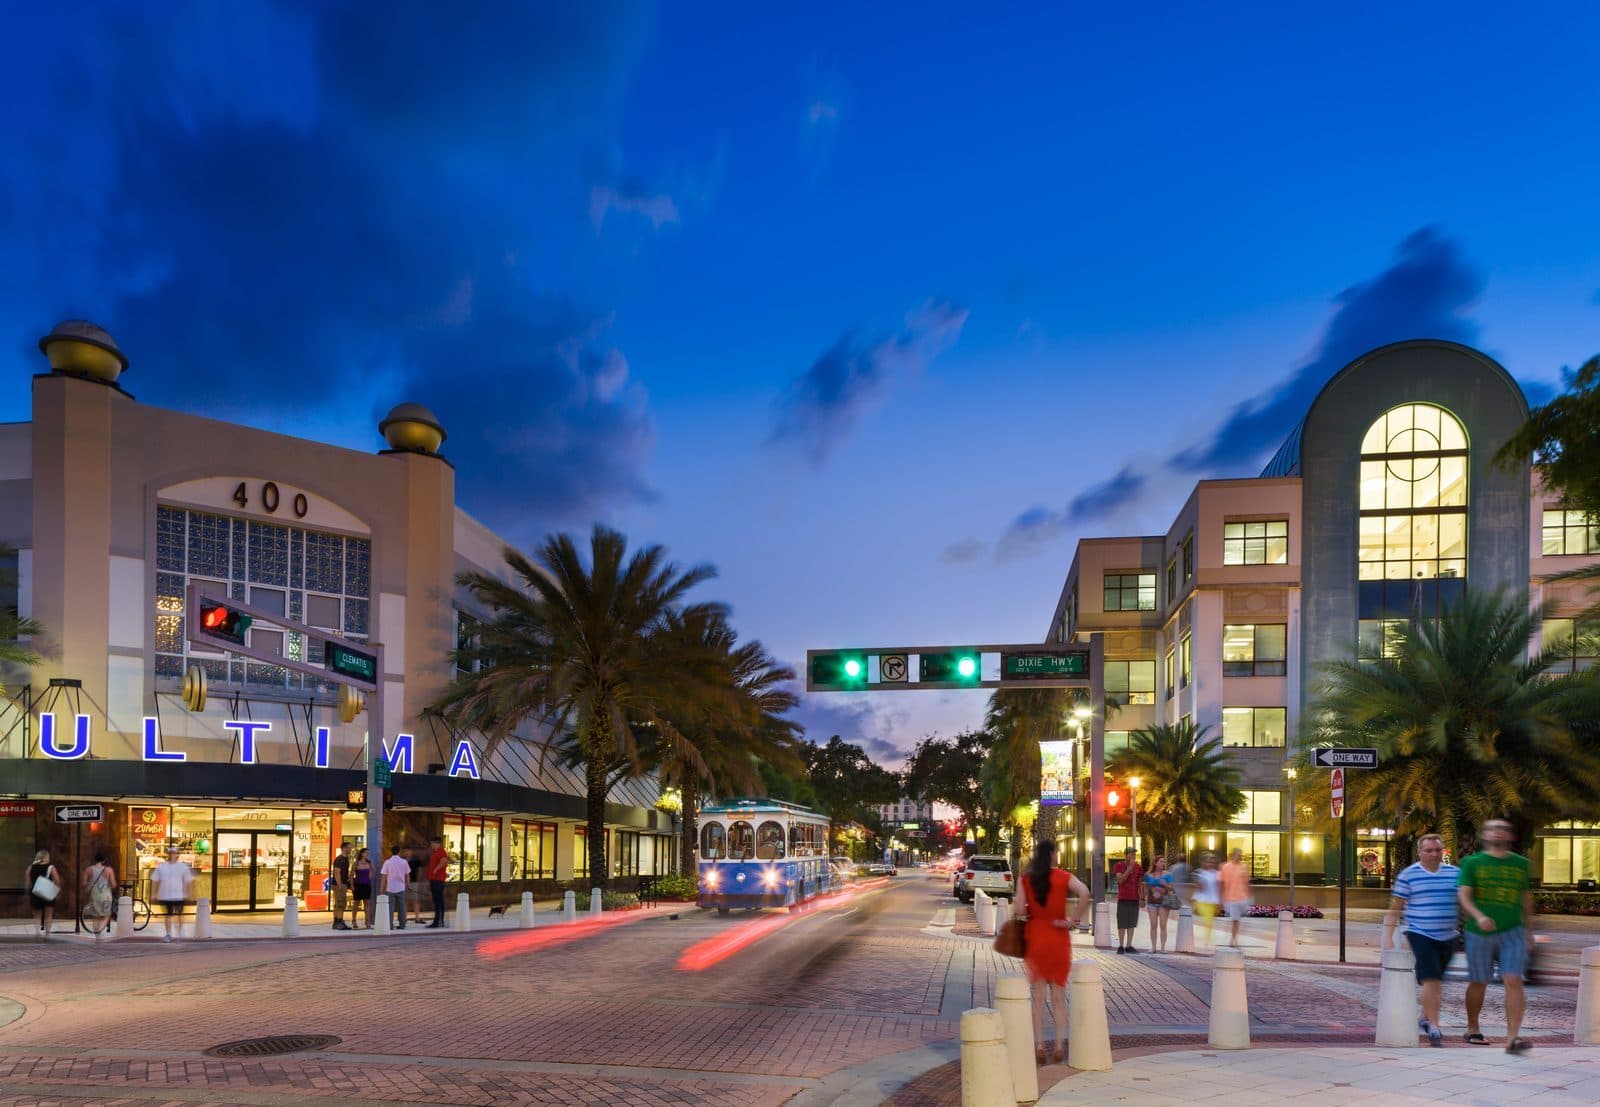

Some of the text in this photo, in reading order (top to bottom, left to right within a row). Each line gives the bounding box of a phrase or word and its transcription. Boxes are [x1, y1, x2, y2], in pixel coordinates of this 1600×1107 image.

[232, 482, 308, 518] 400
[342, 652, 367, 669] CLEMATIS
[1018, 656, 1073, 667] DIXIE HWY
[39, 712, 480, 780] ULTIMA
[1333, 754, 1370, 762] ONE WAY
[82, 809, 96, 817] WAY
[134, 823, 164, 833] ZUMBA
